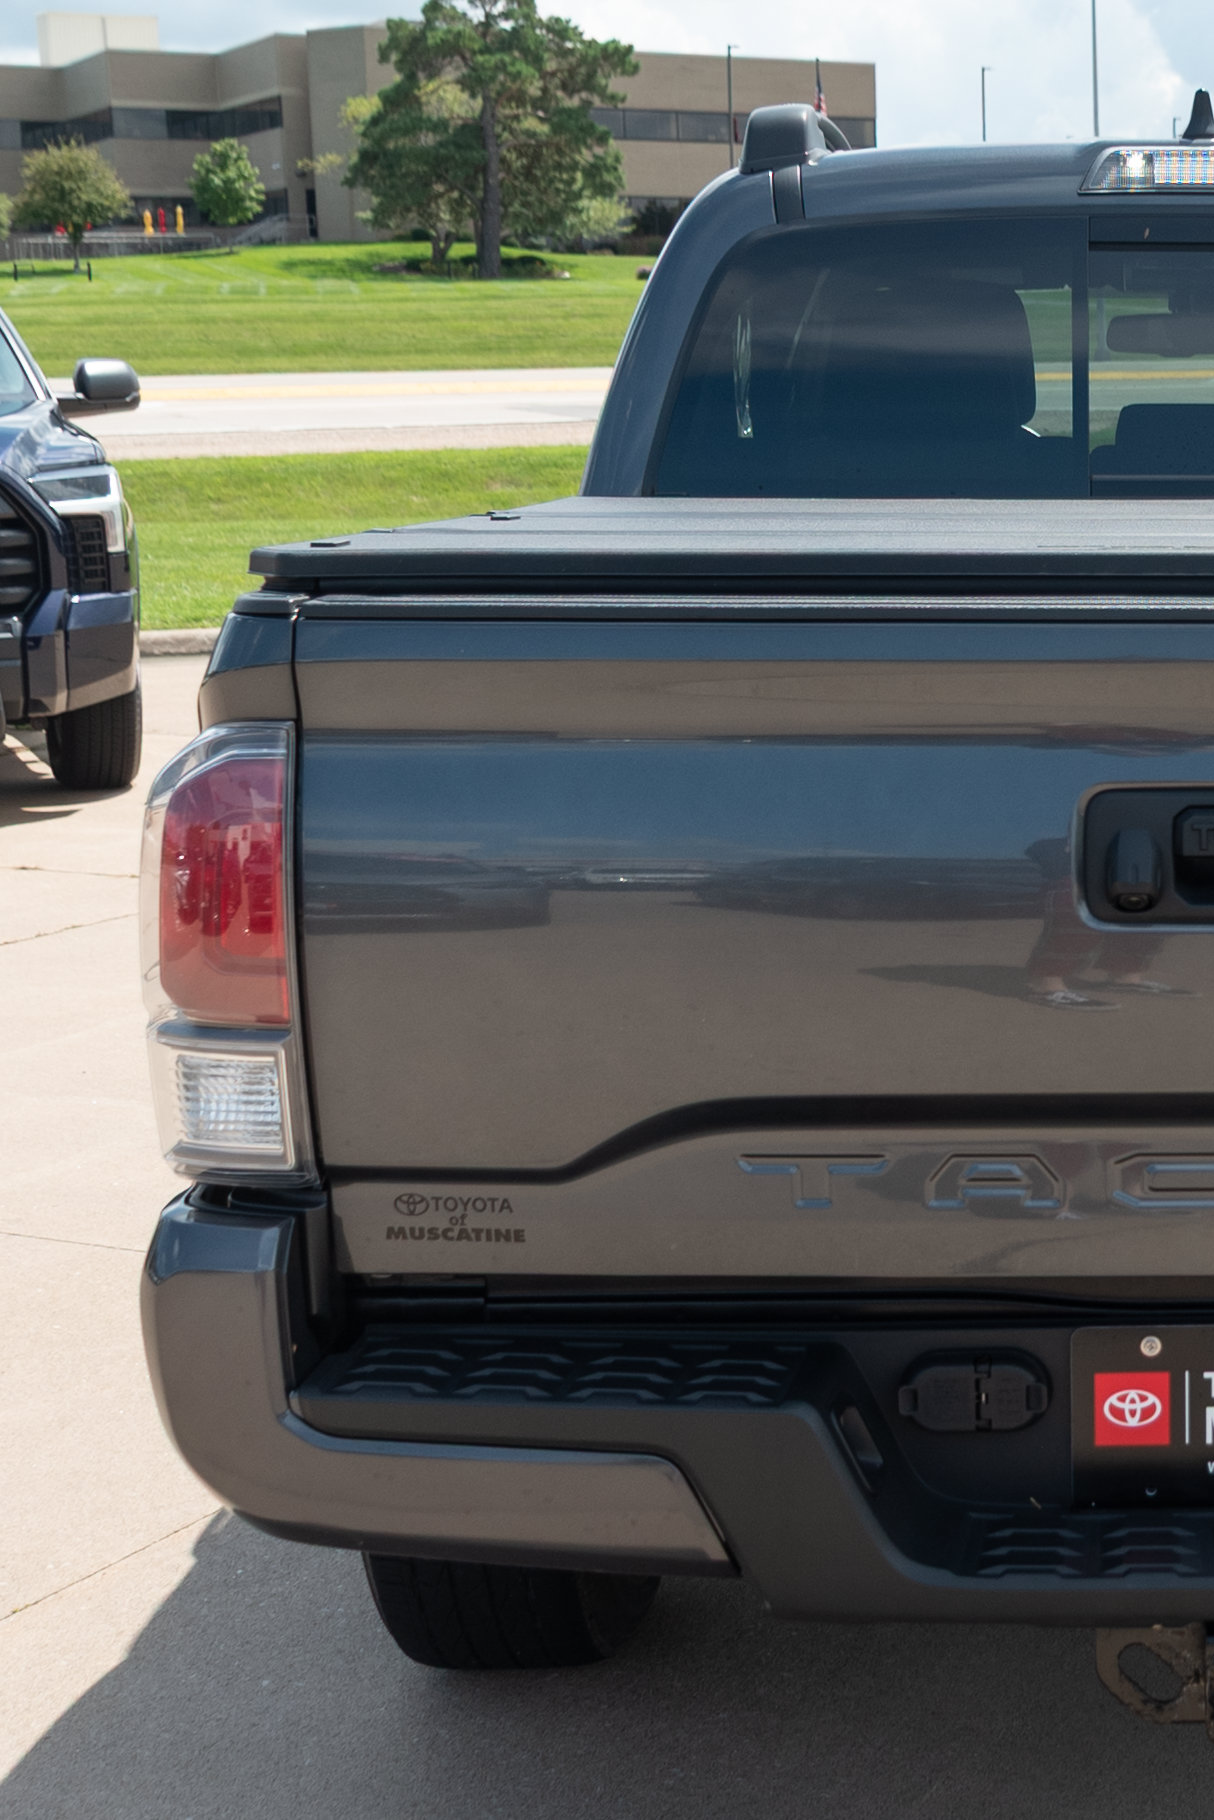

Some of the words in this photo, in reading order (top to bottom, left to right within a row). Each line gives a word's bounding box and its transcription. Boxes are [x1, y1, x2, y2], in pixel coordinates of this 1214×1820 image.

[430, 1196, 513, 1213] TOYOTA
[448, 1213, 468, 1226] of
[385, 1226, 526, 1243] MUSCATINE
